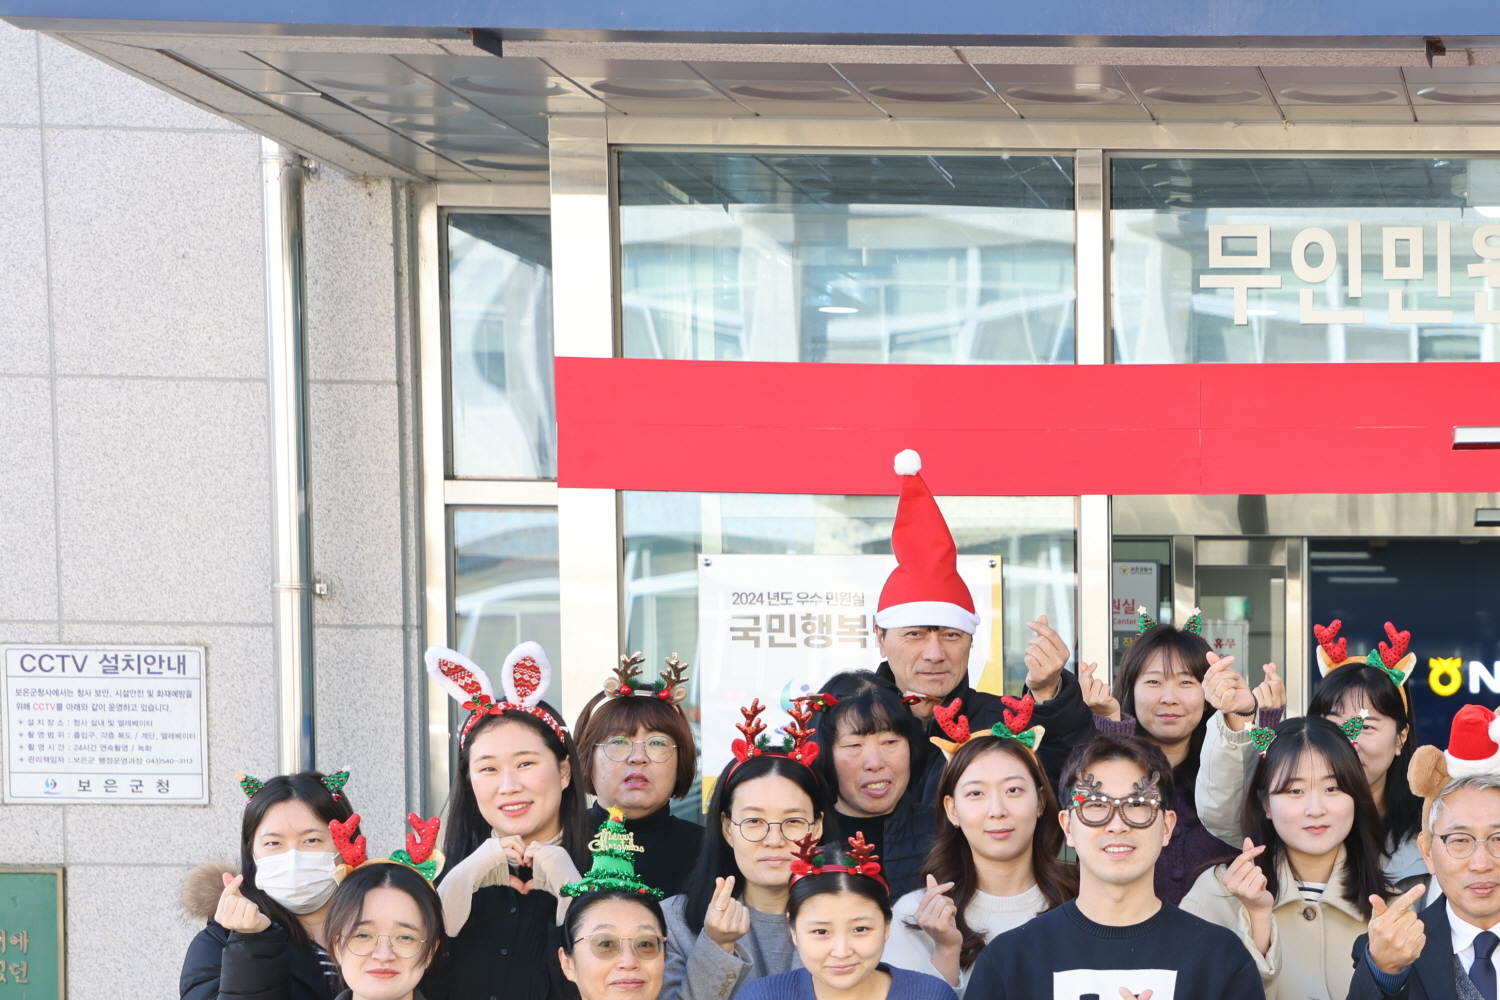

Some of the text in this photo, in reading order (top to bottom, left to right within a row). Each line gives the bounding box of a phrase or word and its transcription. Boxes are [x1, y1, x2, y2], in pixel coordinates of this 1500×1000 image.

[732, 590, 865, 607] 2024 년도 우수 민원실
[20, 653, 187, 676] CCTV 설치안내
[15, 688, 74, 698] 보은군청사에서는
[77, 689, 92, 698] 청사
[115, 689, 144, 699] 시설안전
[146, 689, 154, 699] 및
[16, 702, 31, 711] 위해
[33, 702, 63, 711] CCTV를
[66, 702, 88, 711] 아래와
[91, 702, 106, 712] 같이
[108, 703, 138, 712] 운영하고
[594, 828, 634, 845] Merry
[588, 839, 645, 853] Christmas
